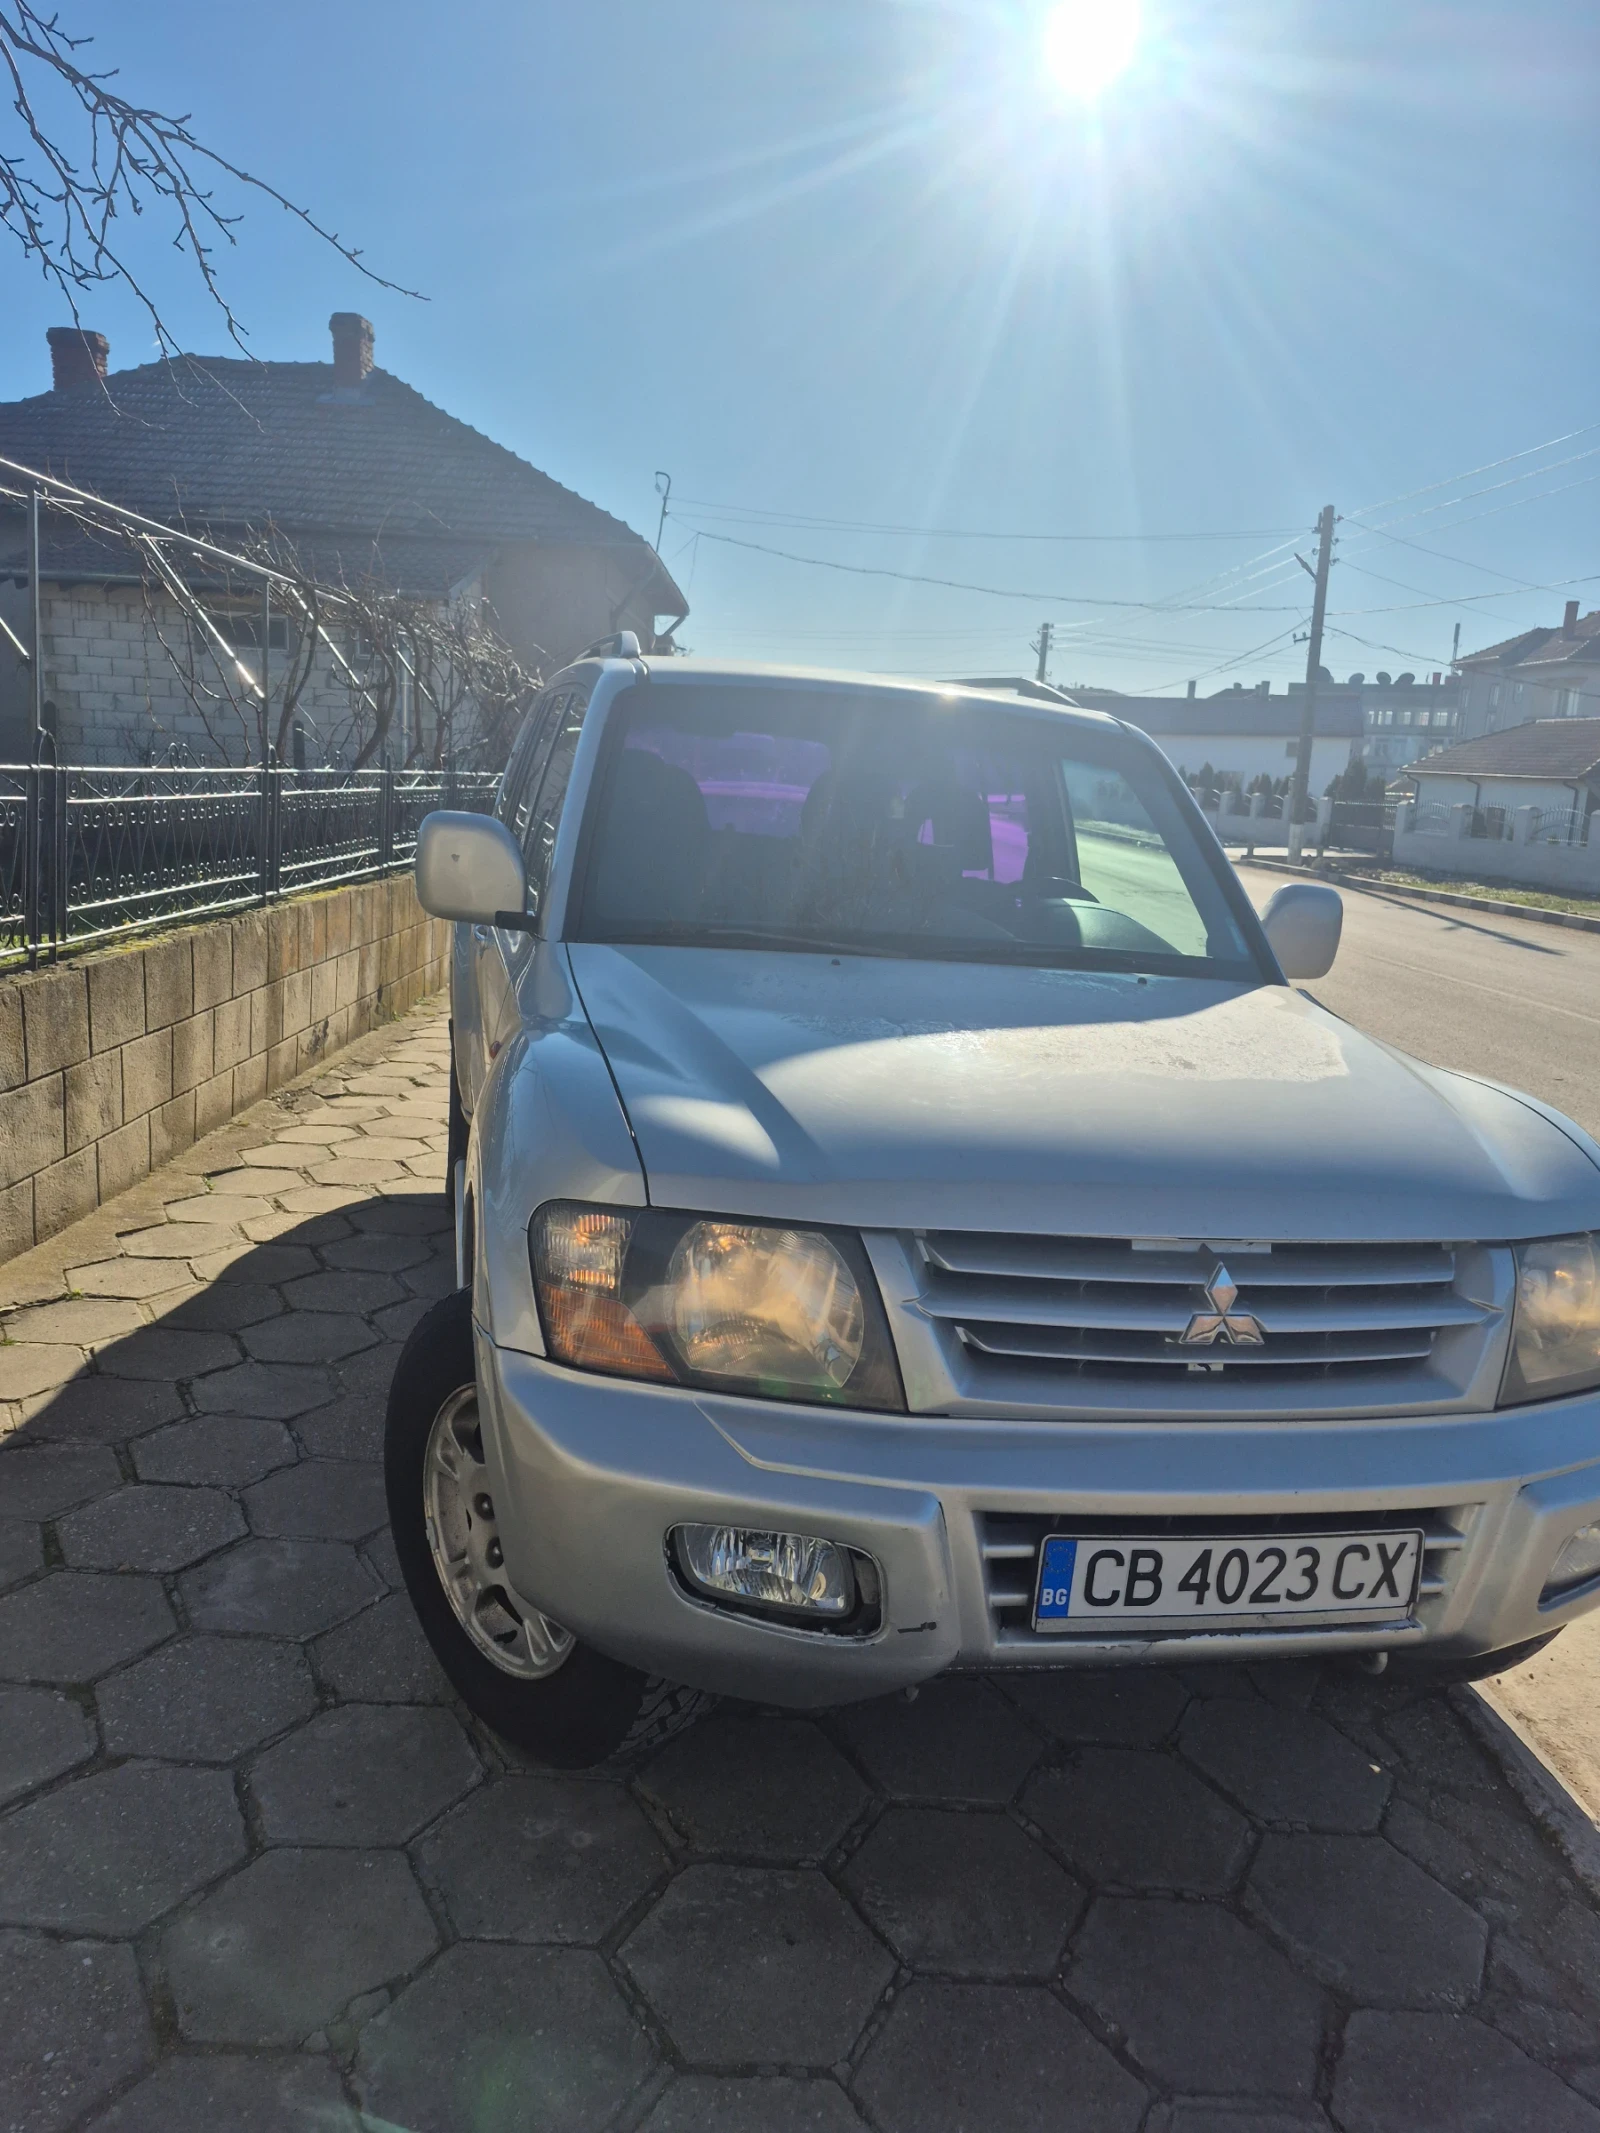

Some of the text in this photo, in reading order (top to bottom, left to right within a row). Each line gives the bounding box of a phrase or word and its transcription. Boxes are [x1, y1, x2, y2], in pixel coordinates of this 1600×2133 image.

[1083, 1541, 1408, 1607] CB 4023 CX
[1041, 1588, 1067, 1606] BG
